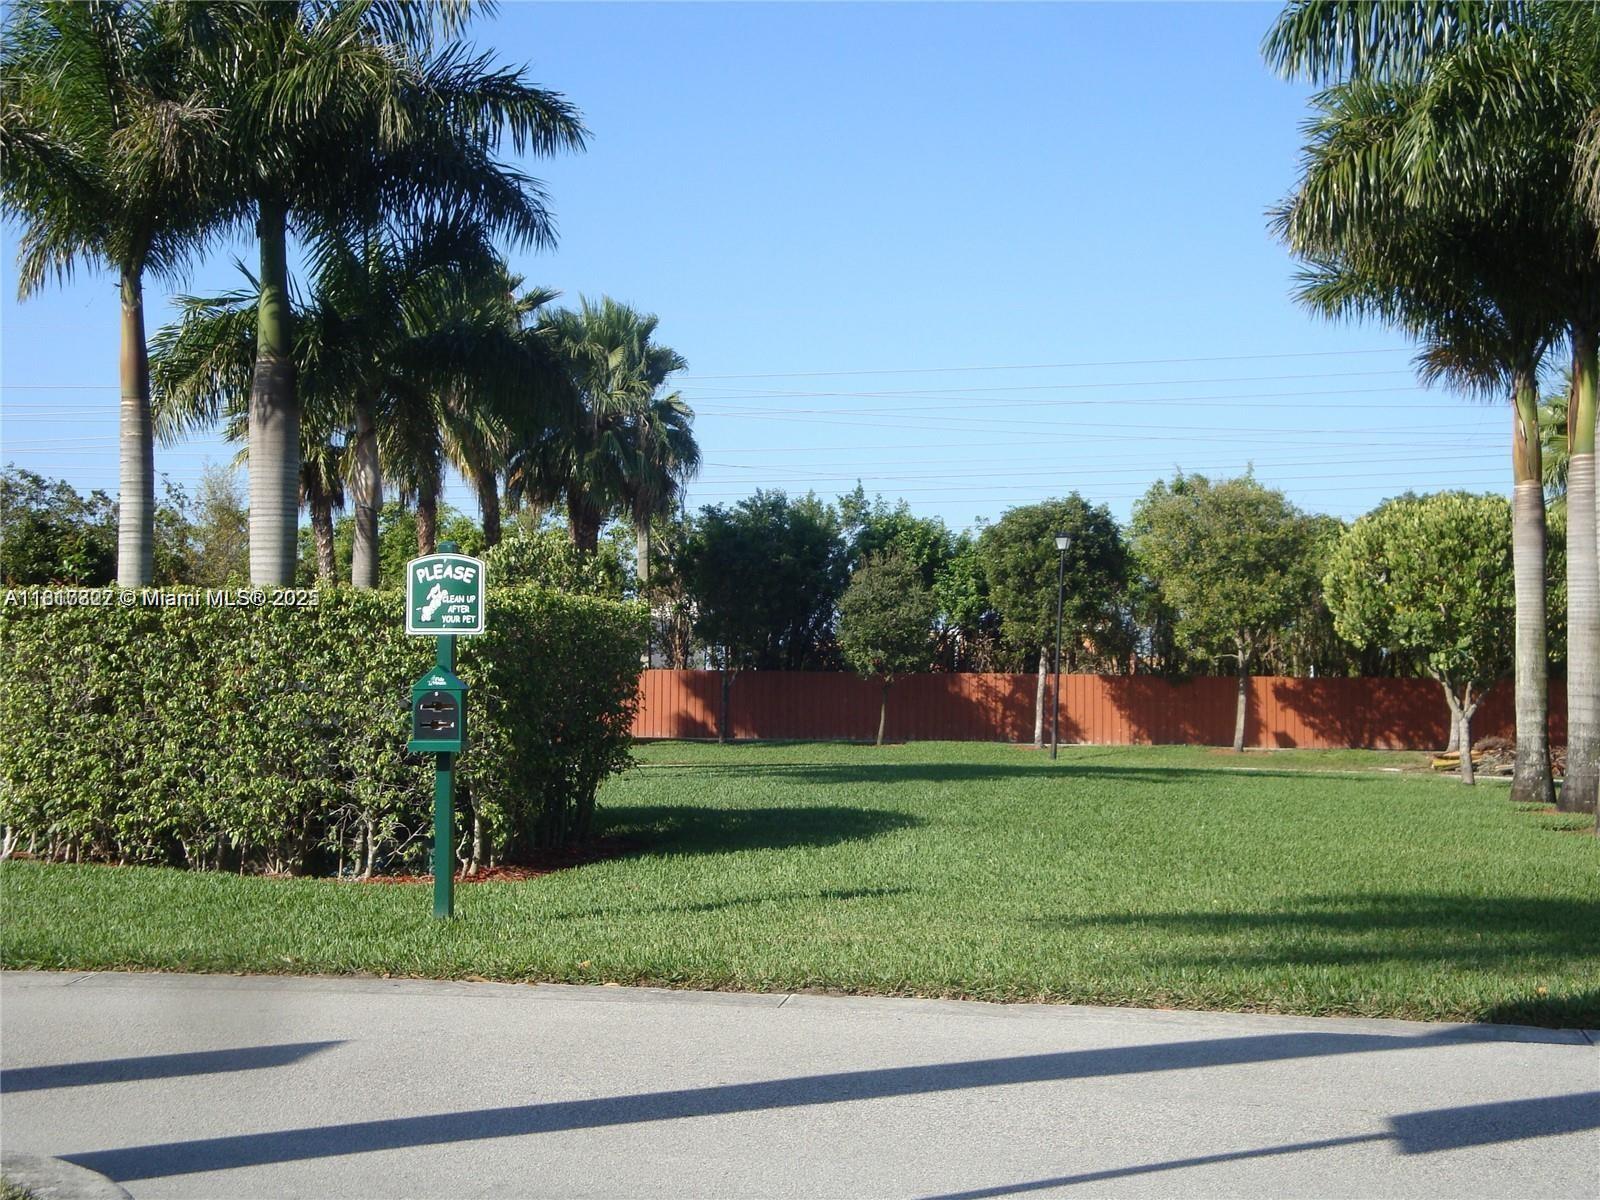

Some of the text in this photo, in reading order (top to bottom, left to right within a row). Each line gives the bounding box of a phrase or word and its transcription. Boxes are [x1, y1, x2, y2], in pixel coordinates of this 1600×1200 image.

[416, 563, 477, 584] PLEASE
[442, 595, 476, 603] CLEAN UP
[447, 605, 470, 613] AFTER
[441, 614, 476, 624] YOUR PET
